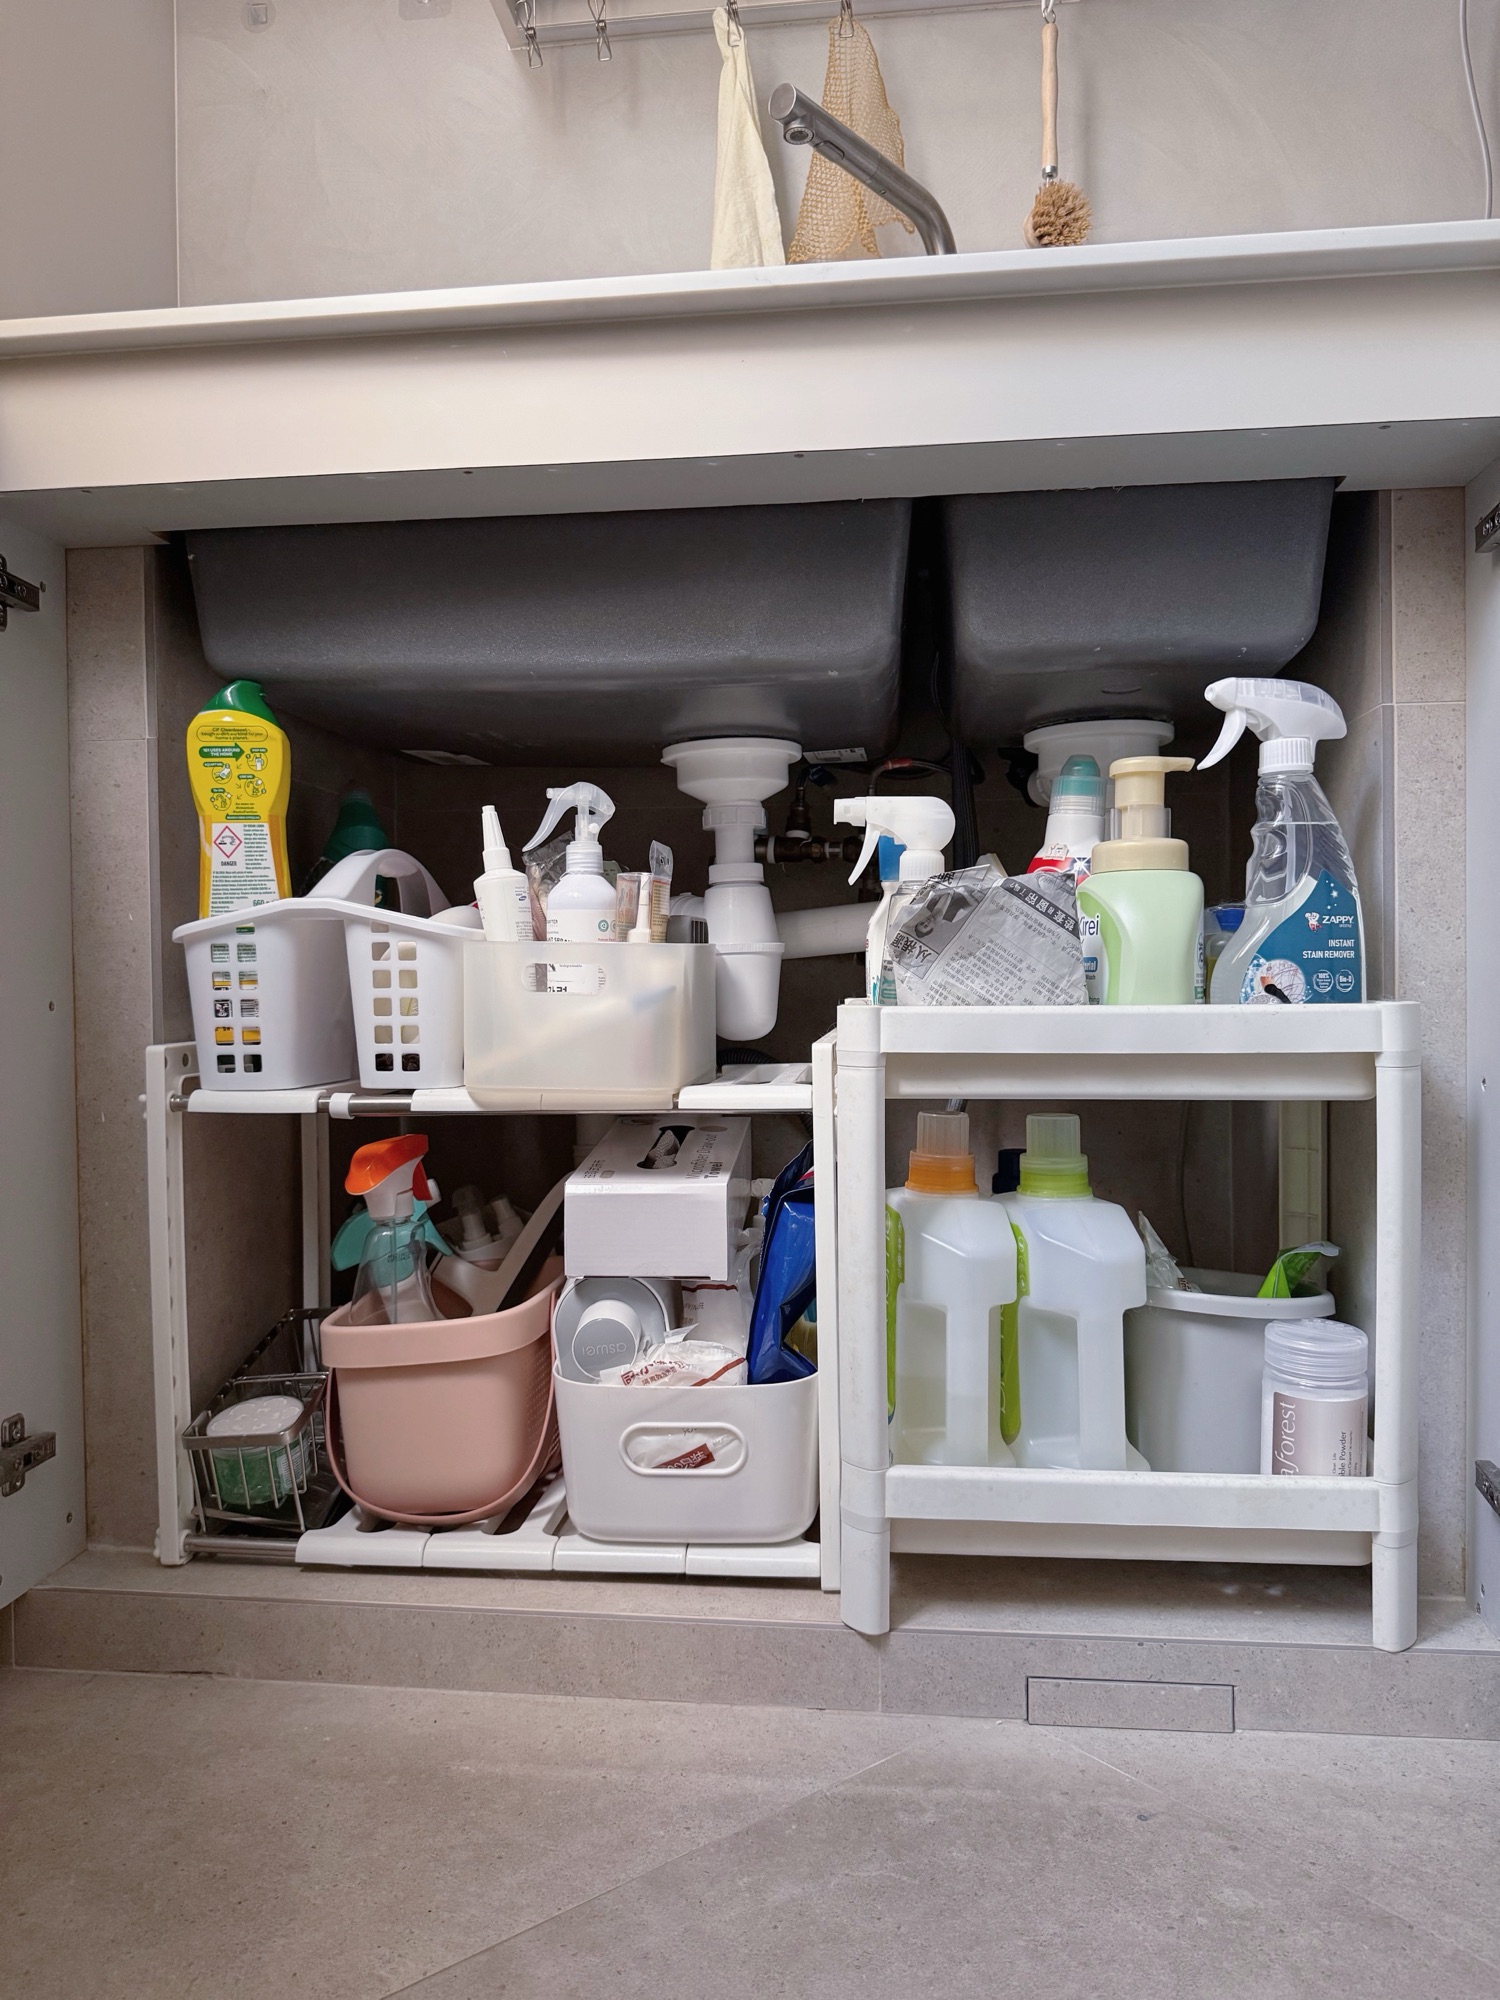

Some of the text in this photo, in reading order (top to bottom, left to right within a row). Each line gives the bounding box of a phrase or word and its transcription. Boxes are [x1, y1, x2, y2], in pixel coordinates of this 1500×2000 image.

[1328, 939, 1354, 947] INSTANT
[685, 1154, 708, 1180] Microfiber
[704, 1162, 724, 1178] Towel
